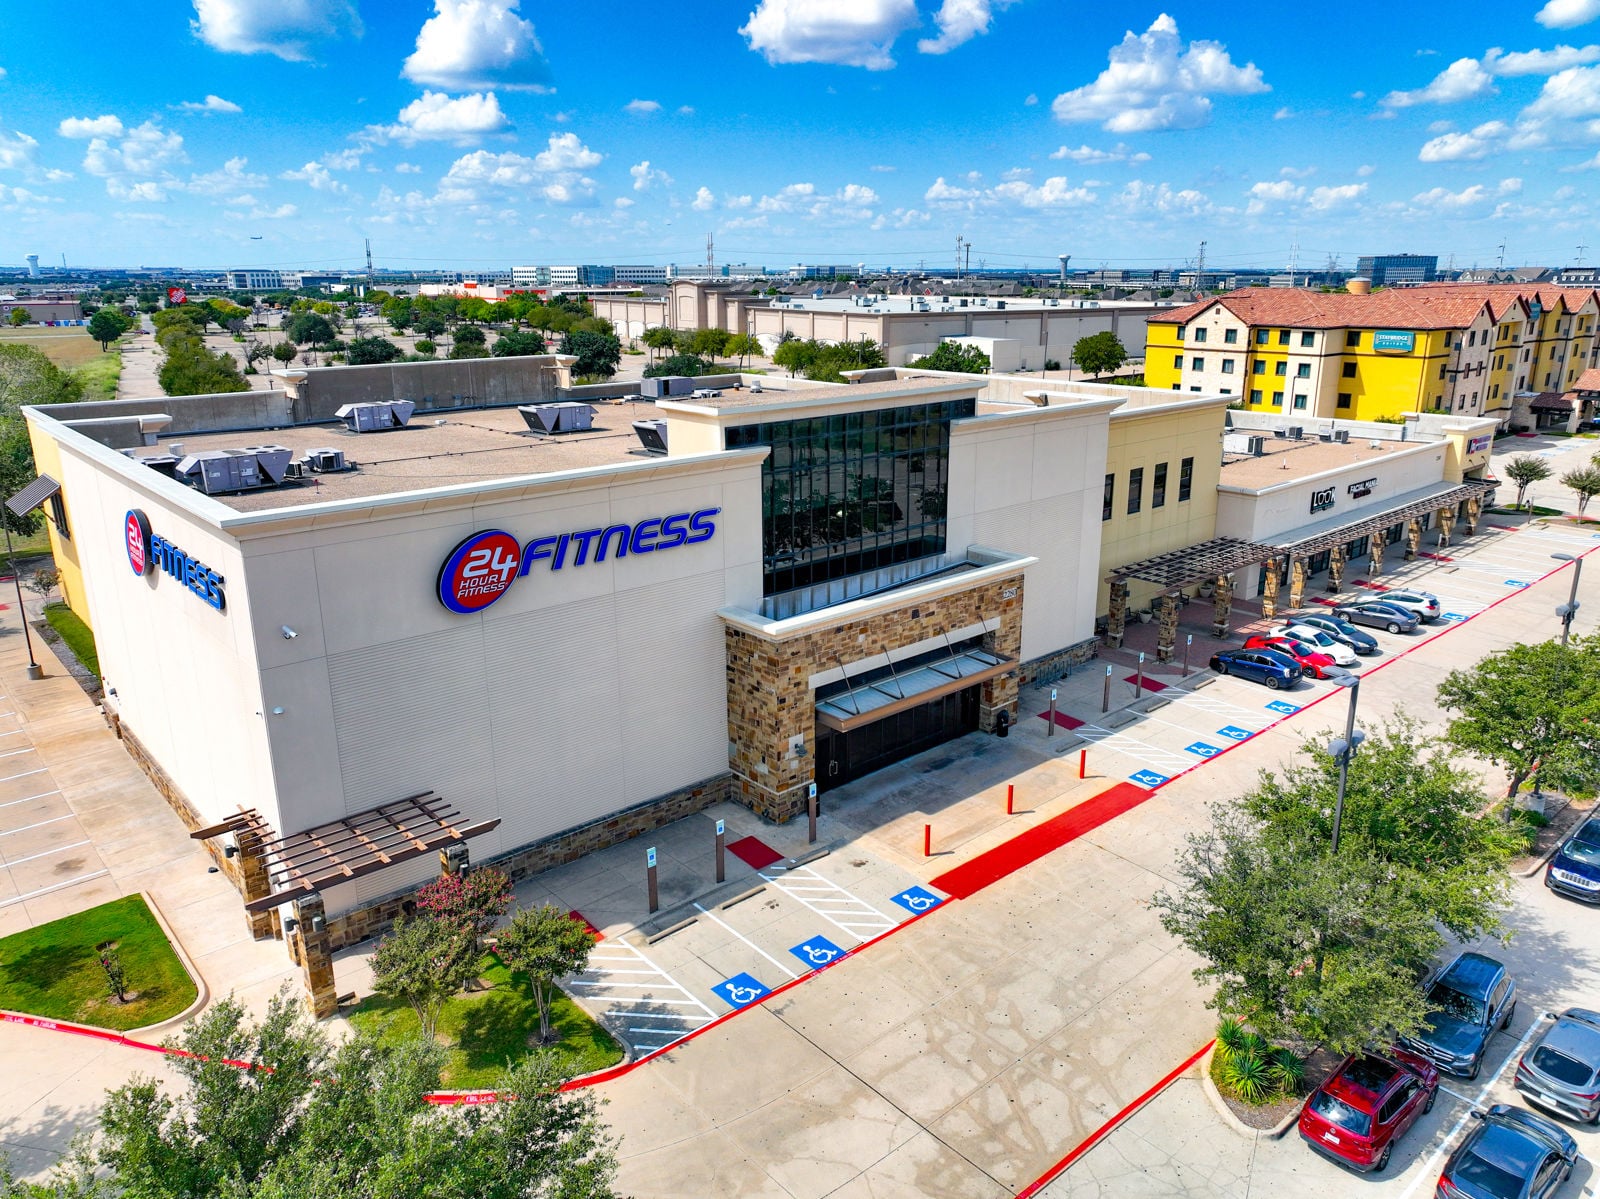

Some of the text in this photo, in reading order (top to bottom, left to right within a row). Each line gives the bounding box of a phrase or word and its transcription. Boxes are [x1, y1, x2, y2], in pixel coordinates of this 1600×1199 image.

[1312, 487, 1336, 507] LOOK
[462, 508, 719, 580] 24 FITNESS
[127, 523, 225, 611] 24 FITNESS
[457, 583, 505, 599] FITNESS
[459, 574, 498, 590] HOUR
